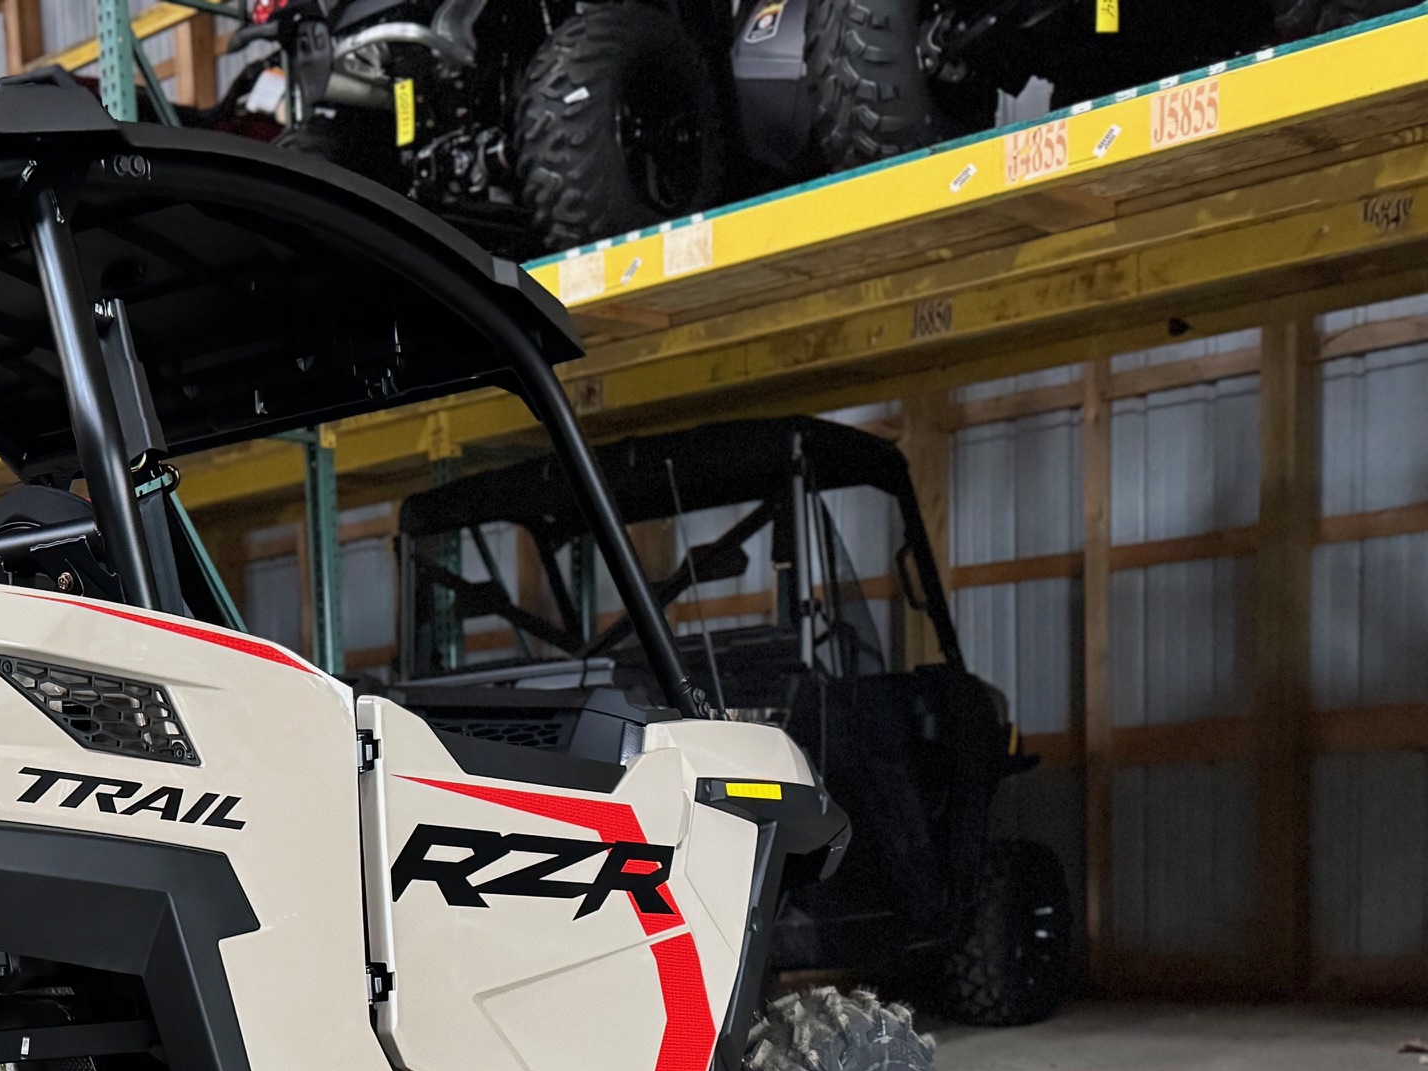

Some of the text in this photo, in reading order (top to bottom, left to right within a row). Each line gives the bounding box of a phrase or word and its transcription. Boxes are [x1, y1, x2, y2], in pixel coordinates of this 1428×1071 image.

[1153, 81, 1219, 143] J5855
[16, 766, 247, 831] TRAIL
[390, 823, 677, 921] RZR
